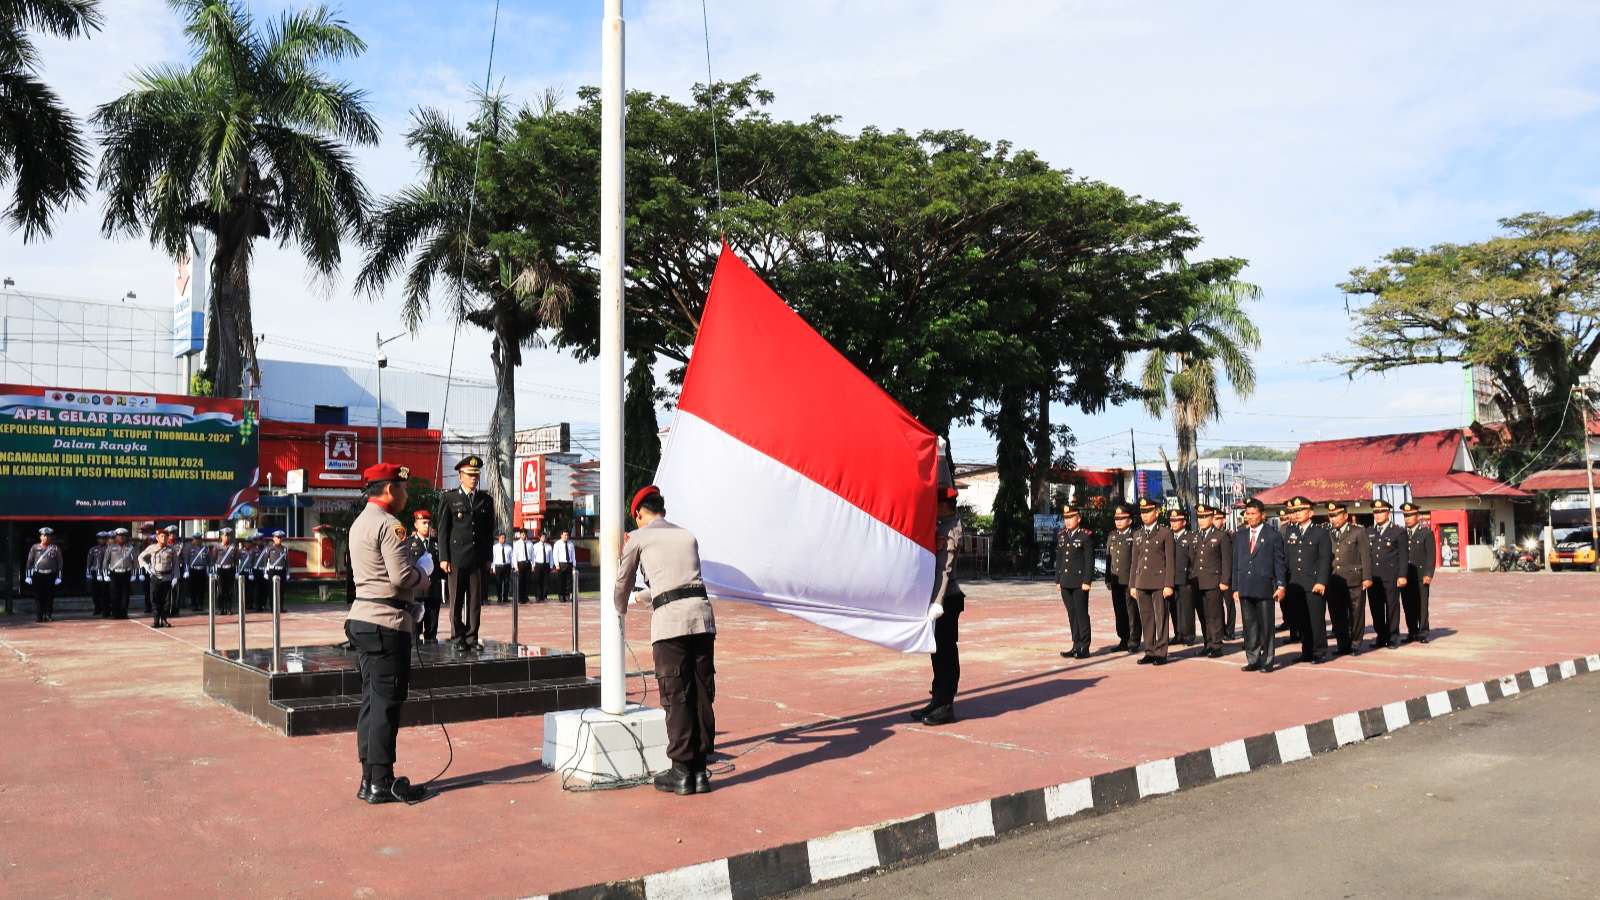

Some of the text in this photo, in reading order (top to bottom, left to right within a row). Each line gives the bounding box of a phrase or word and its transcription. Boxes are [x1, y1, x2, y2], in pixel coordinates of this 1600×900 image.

[14, 408, 183, 427] APEL GELAR PASUKAN
[59, 426, 107, 437] TERPUSAT
[52, 439, 147, 453] Dalam Rangka
[62, 453, 84, 464] IDUL
[87, 454, 112, 465] FITRI
[115, 455, 137, 466] 1445
[140, 456, 146, 466] H
[149, 456, 179, 467] TAHUN
[180, 457, 204, 468] 2024
[12, 464, 73, 477] KABUPATEN
[75, 466, 102, 477] POSO
[104, 467, 150, 478] PROVINSI
[152, 469, 199, 480] SULAWESI
[201, 470, 234, 481] TENGAH
